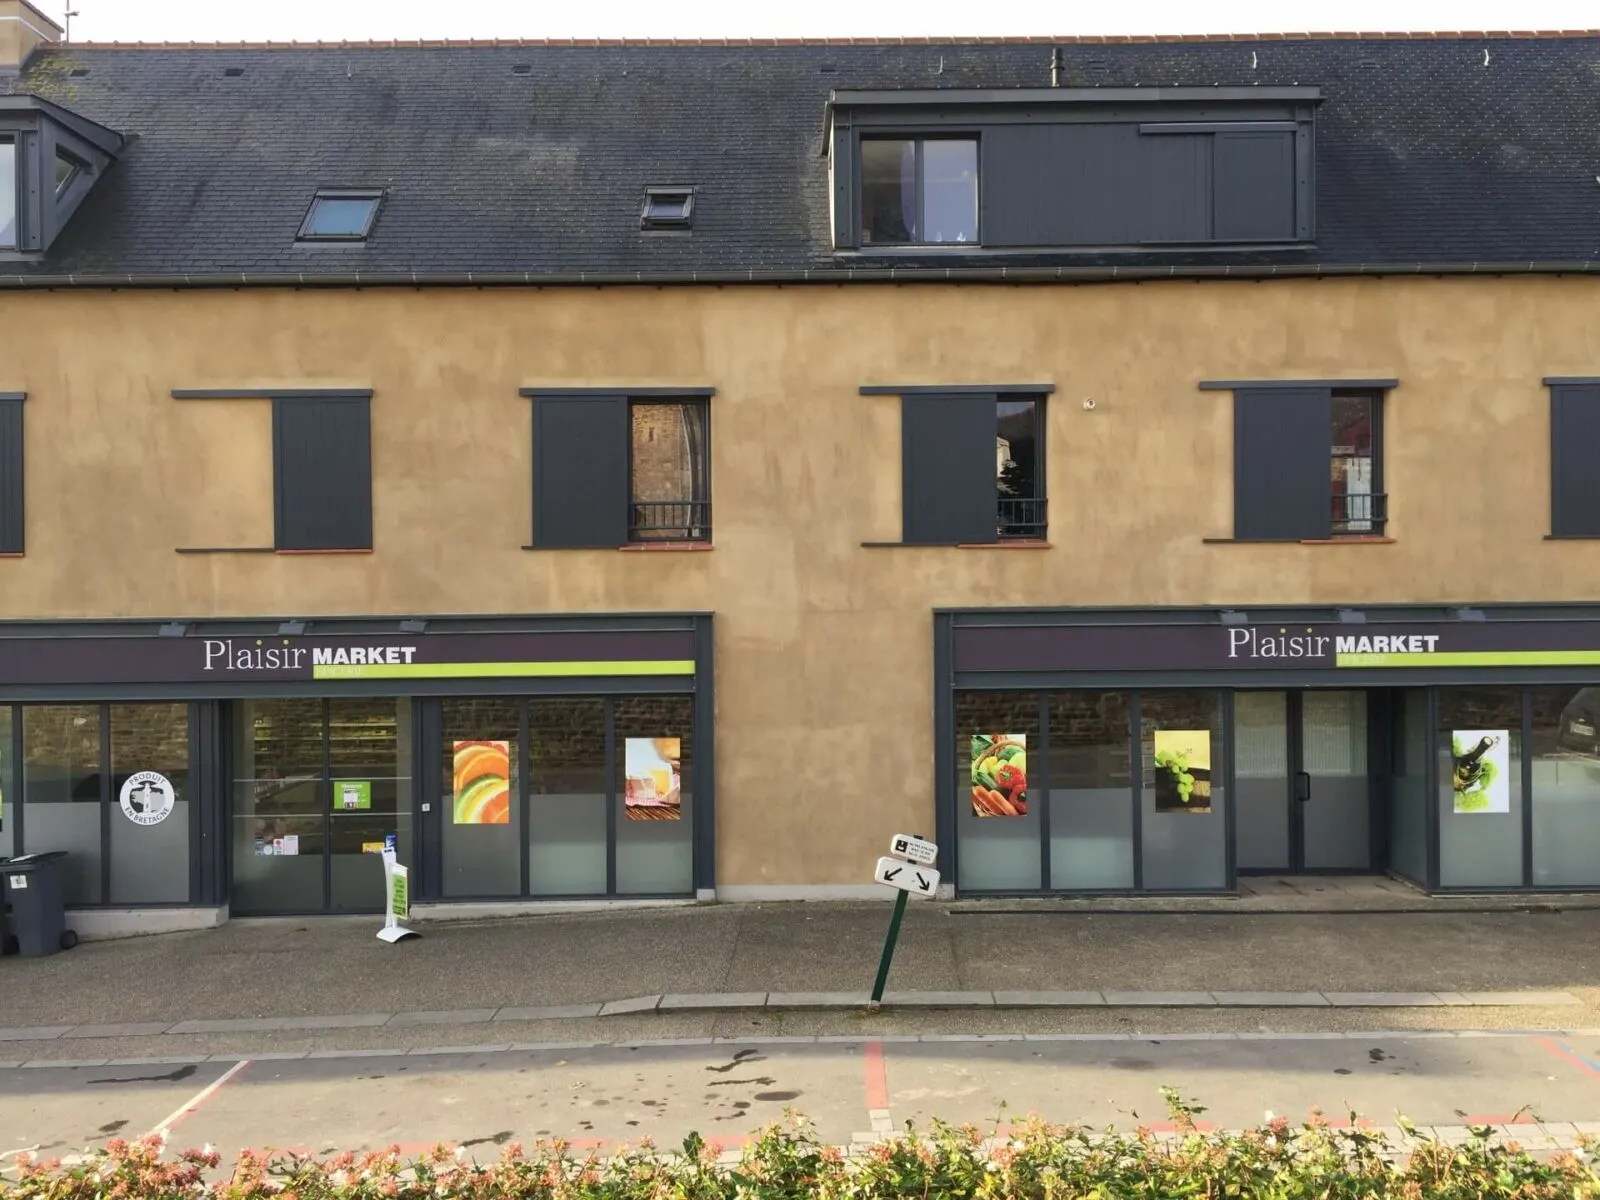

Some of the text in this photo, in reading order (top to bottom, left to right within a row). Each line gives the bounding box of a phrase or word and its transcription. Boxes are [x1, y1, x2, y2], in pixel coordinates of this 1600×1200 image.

[203, 639, 417, 670] Plaisir MARKET
[1227, 627, 1440, 658] Plaisir MARKET
[128, 772, 166, 785] PRODUIT
[125, 806, 169, 823] EN BRETAGNE
